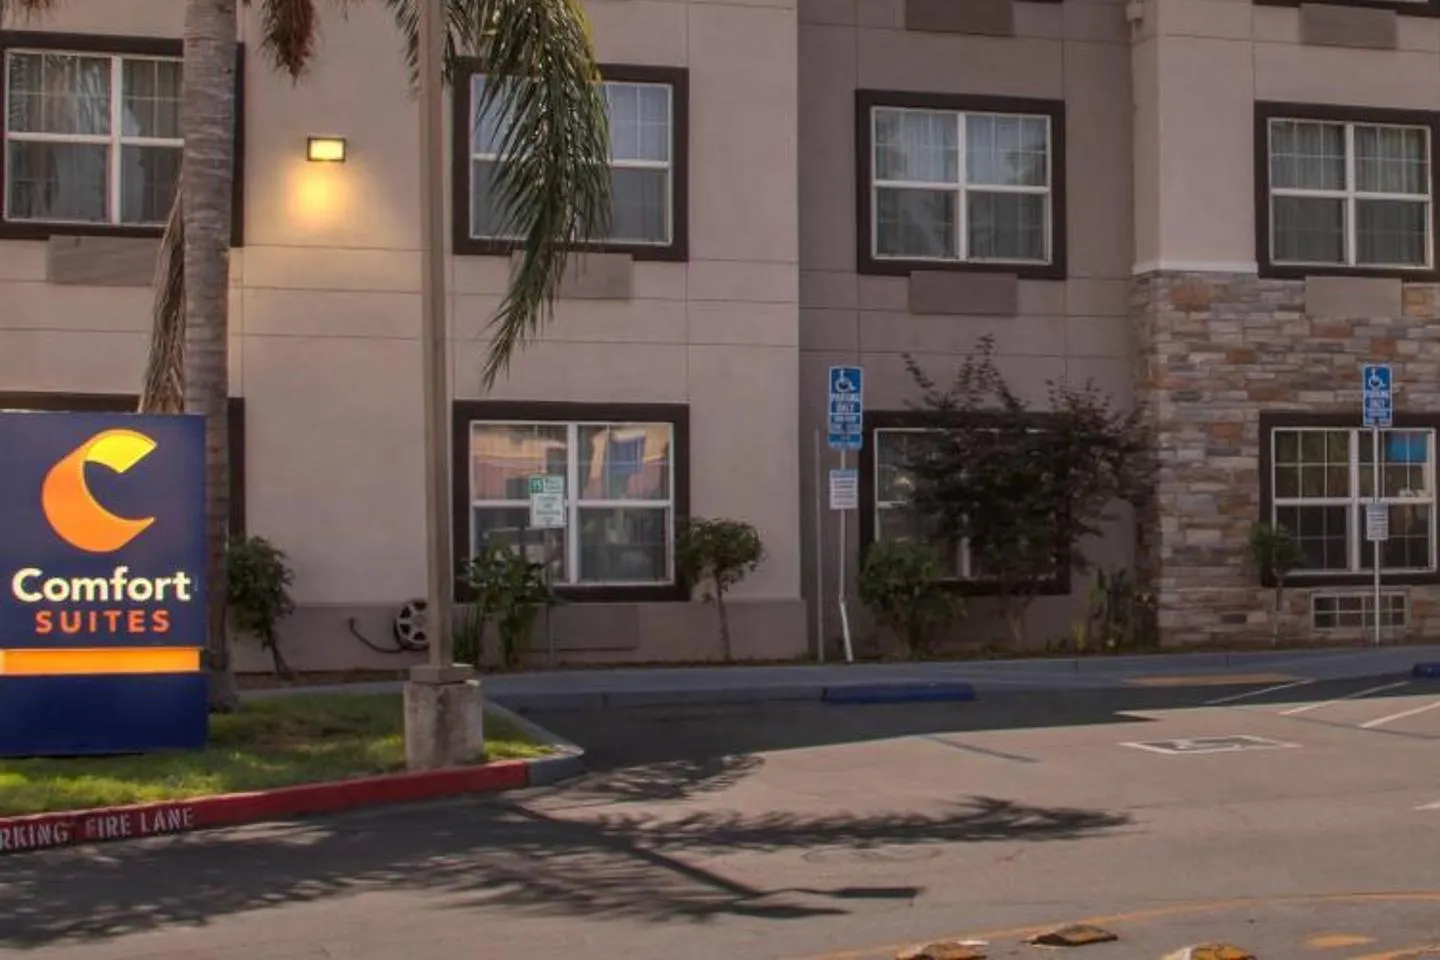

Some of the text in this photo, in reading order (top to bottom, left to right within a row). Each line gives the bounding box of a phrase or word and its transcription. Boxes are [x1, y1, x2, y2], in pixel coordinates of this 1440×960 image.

[12, 566, 191, 602] Comfort
[35, 610, 170, 634] SUITES
[84, 813, 132, 839] FIRE
[140, 807, 194, 833] LANE
